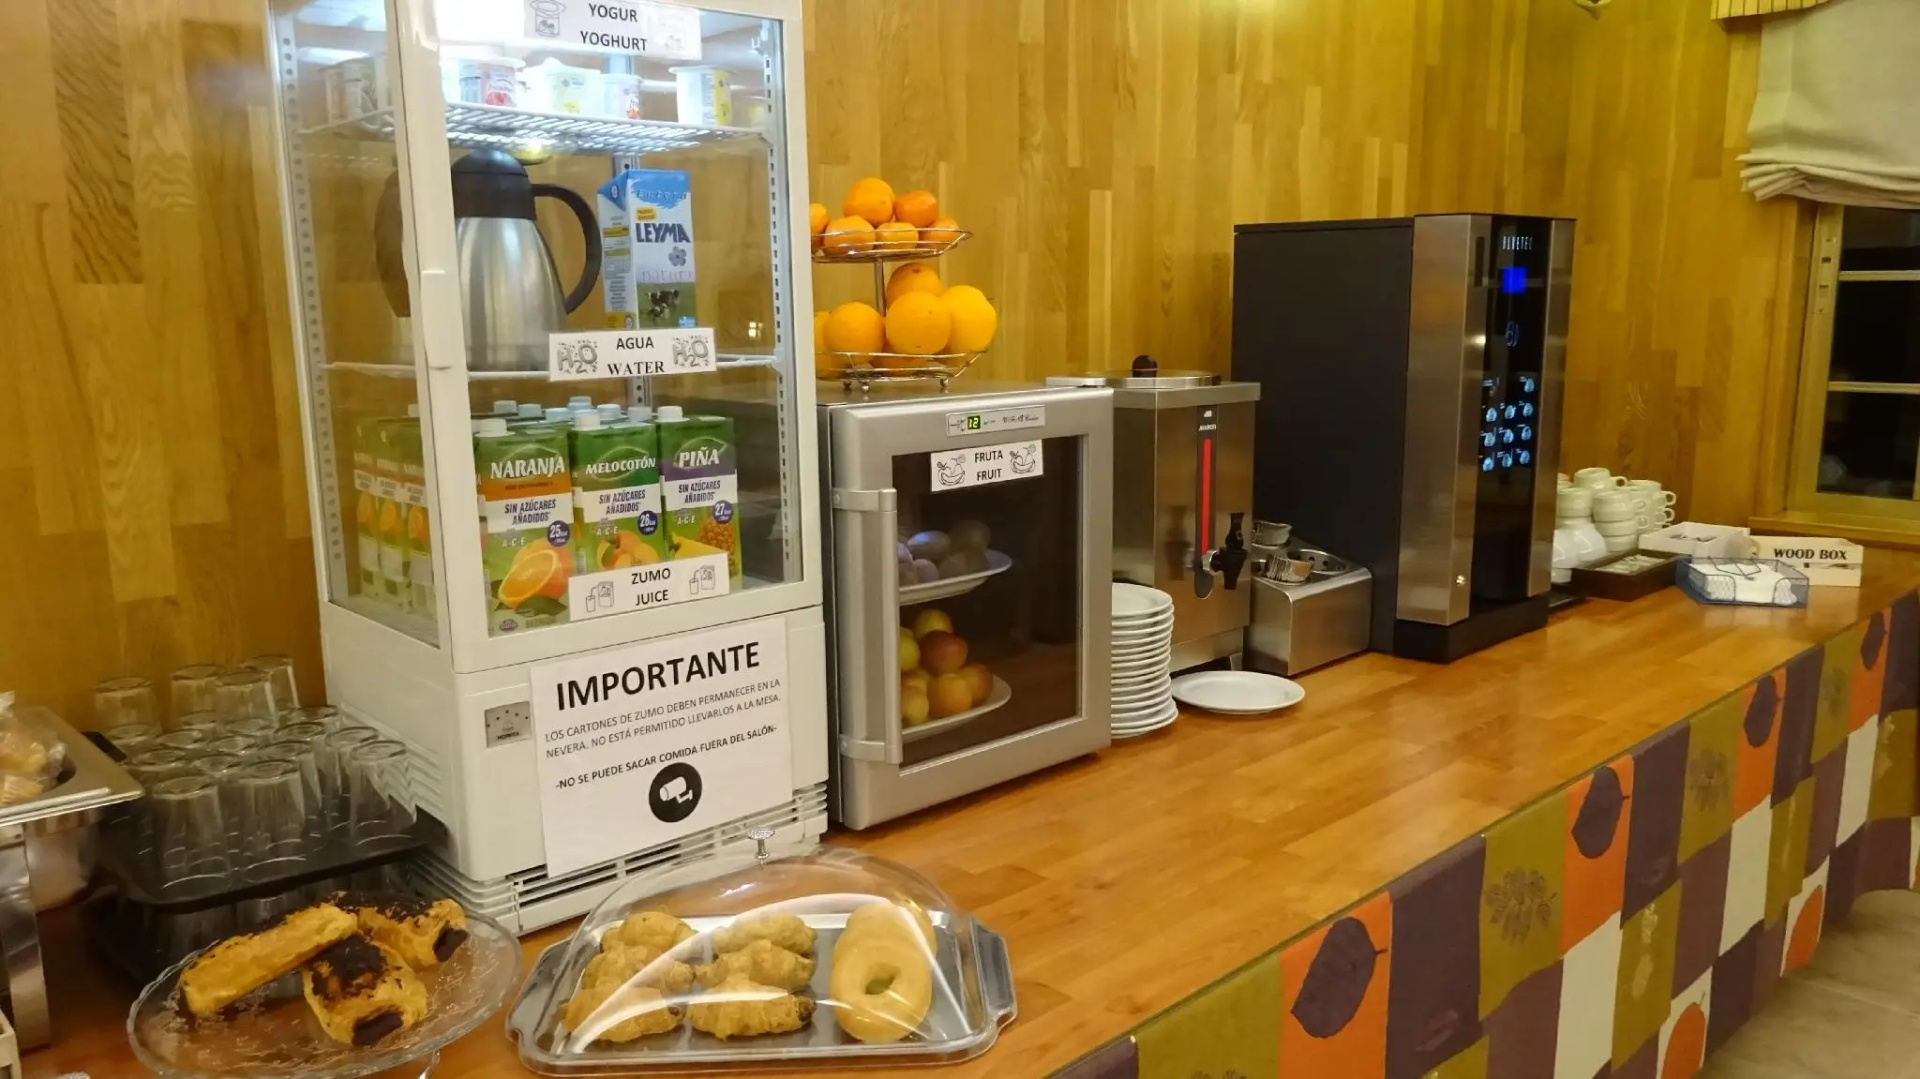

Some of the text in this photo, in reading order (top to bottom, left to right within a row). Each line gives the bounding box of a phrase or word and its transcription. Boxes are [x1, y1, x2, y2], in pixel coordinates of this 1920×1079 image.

[588, 3, 638, 23] YOGUR
[580, 30, 648, 52] YOGHURT
[635, 222, 691, 243] LEYMA
[616, 337, 655, 350] AGUA
[607, 361, 665, 376] WATER
[968, 417, 979, 429] 12
[585, 455, 656, 475] MELOCOTÓN
[678, 446, 720, 468] PIÑA
[974, 450, 1004, 464] FRUTA
[490, 455, 565, 480] NARANJA
[976, 468, 1002, 482] FRUIT
[678, 480, 721, 494] SIN AZÚCARES
[599, 489, 646, 505] SIN AZÚCARES
[504, 499, 556, 514] SIN AZÚCARES
[1773, 548, 1848, 560] WOOD BOX
[631, 567, 671, 585] ZUMO
[635, 589, 669, 606] JUICE
[557, 641, 760, 711] IMPORTANTE
[545, 679, 781, 742] LOS CARTONES DE ZUMO DEBEN PERMANECER EN LA
[546, 694, 781, 759] NEVERA. NO ESTÁ PERMITIDO LLEVARLOS A LA MESA.
[578, 773, 589, 784] SE
[592, 764, 624, 780] PUEDE
[626, 755, 657, 772] SACAR
[659, 745, 698, 763] COMIDA
[700, 738, 728, 752] FUERA
[730, 733, 745, 744] DEL
